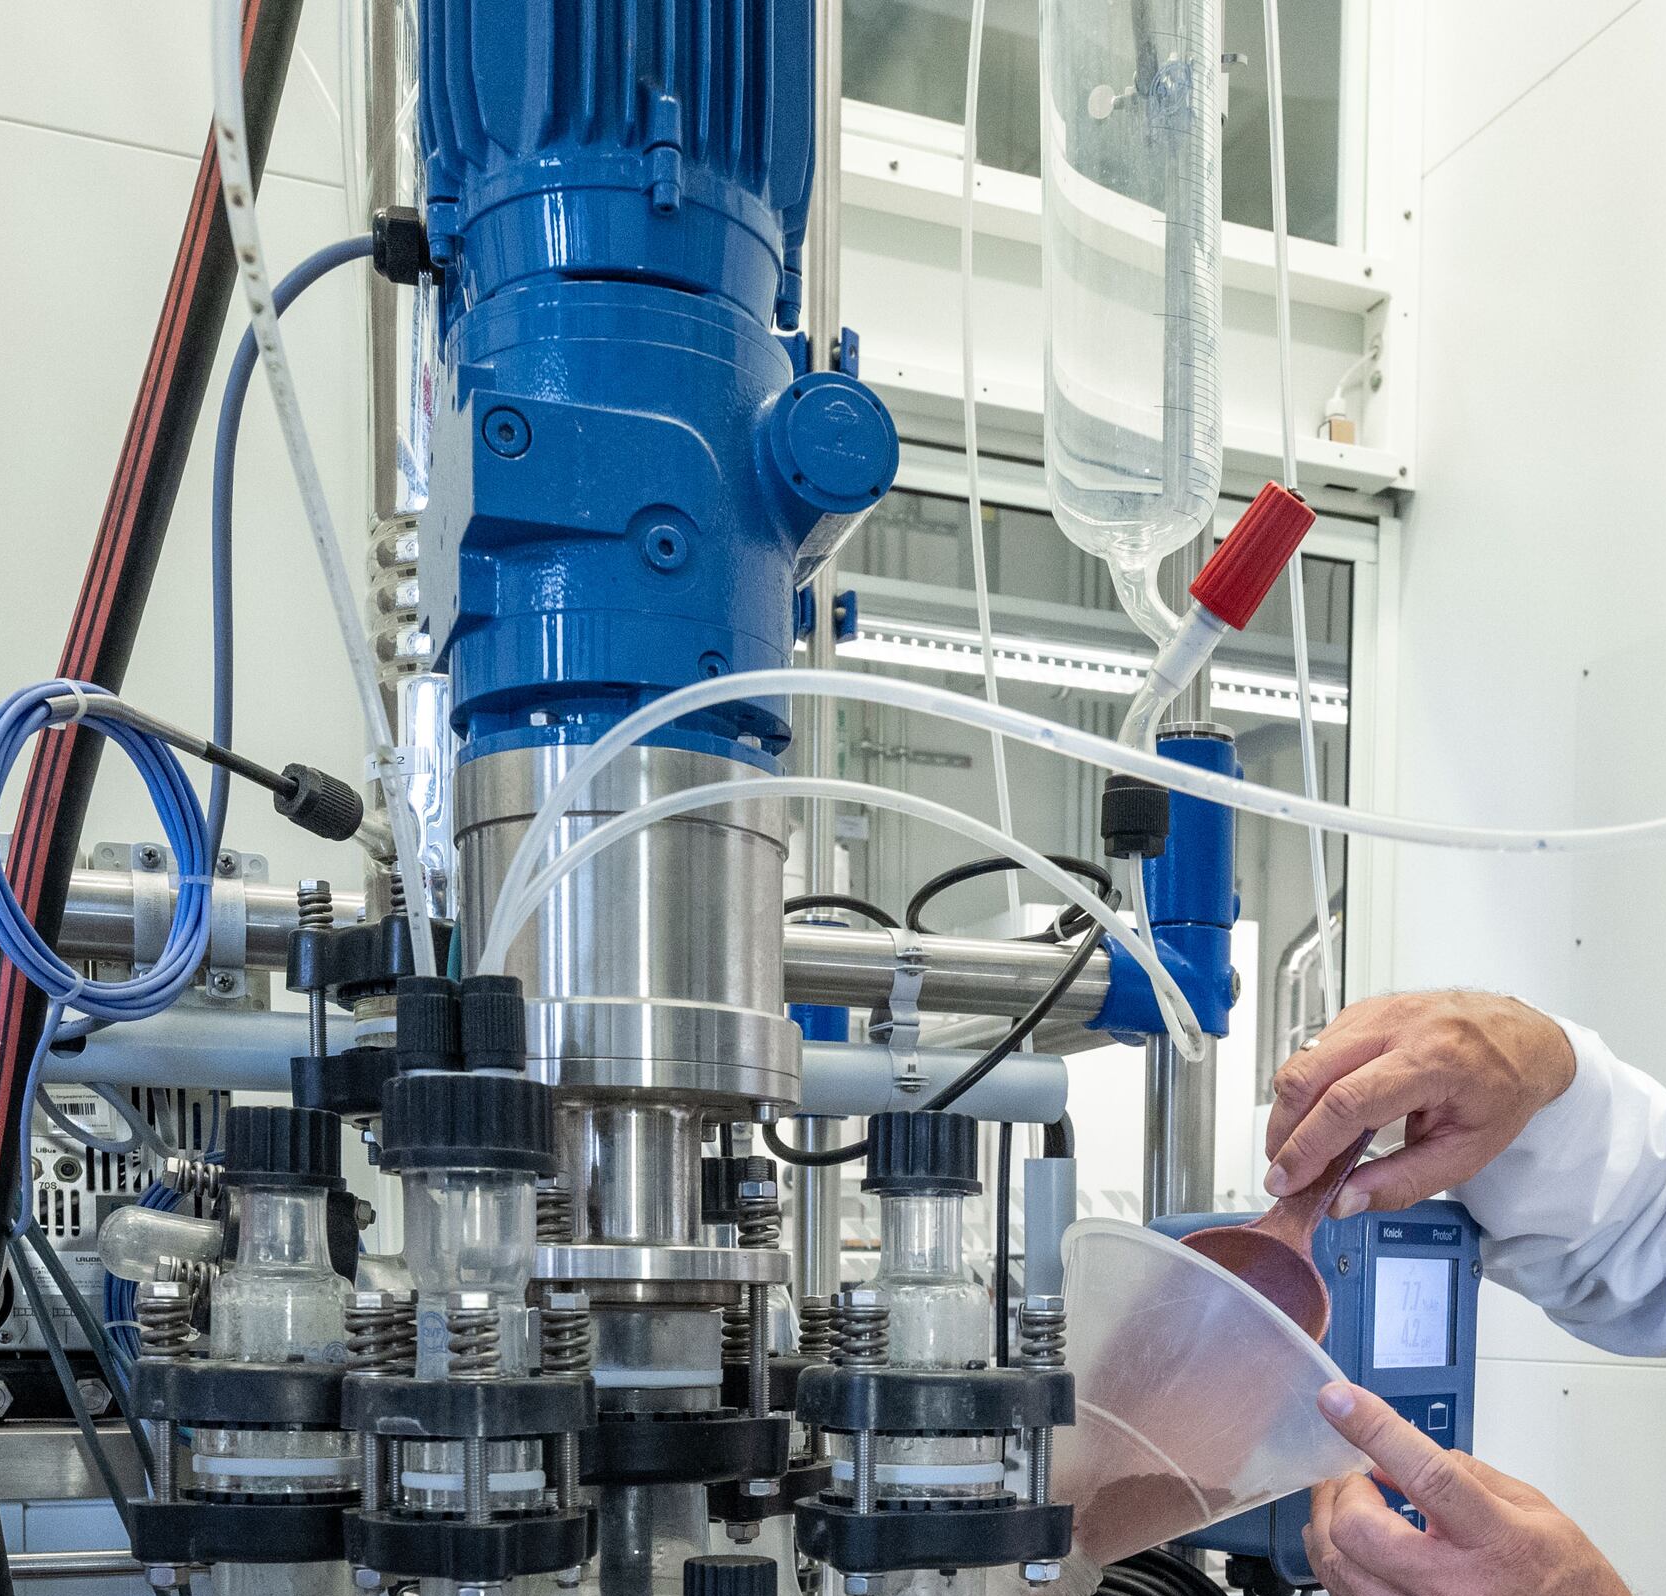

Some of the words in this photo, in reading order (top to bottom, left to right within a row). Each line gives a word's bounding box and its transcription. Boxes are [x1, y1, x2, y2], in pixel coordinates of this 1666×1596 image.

[38, 1181, 58, 1190] 70S
[1383, 1227, 1404, 1239] Knick
[1401, 1319, 1420, 1348] 4.2
